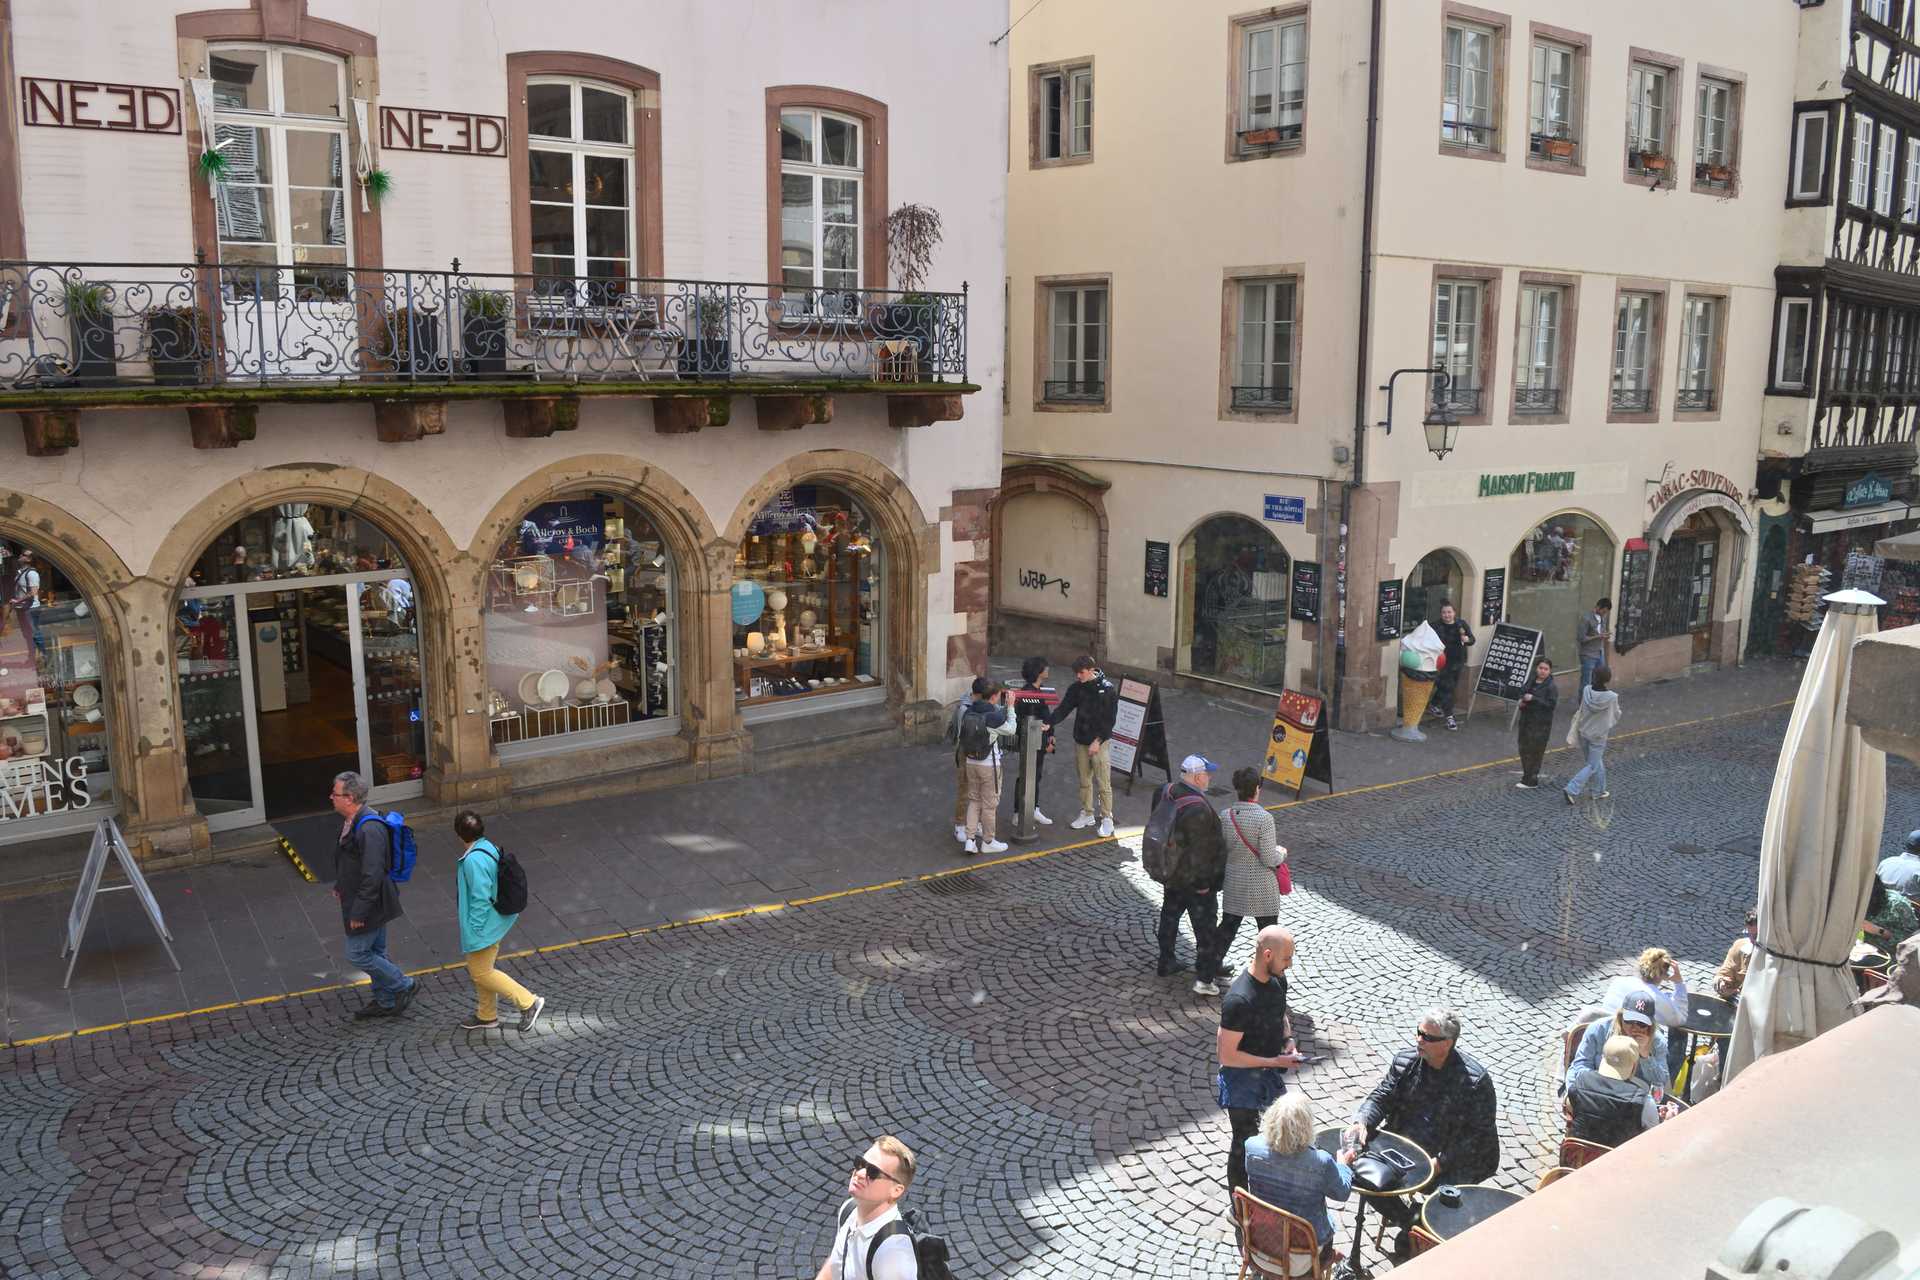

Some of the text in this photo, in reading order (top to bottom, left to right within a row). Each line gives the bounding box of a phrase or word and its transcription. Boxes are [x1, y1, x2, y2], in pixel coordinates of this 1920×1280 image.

[1478, 471, 1576, 497] MAISON FRANCHI
[575, 523, 598, 535] Boch
